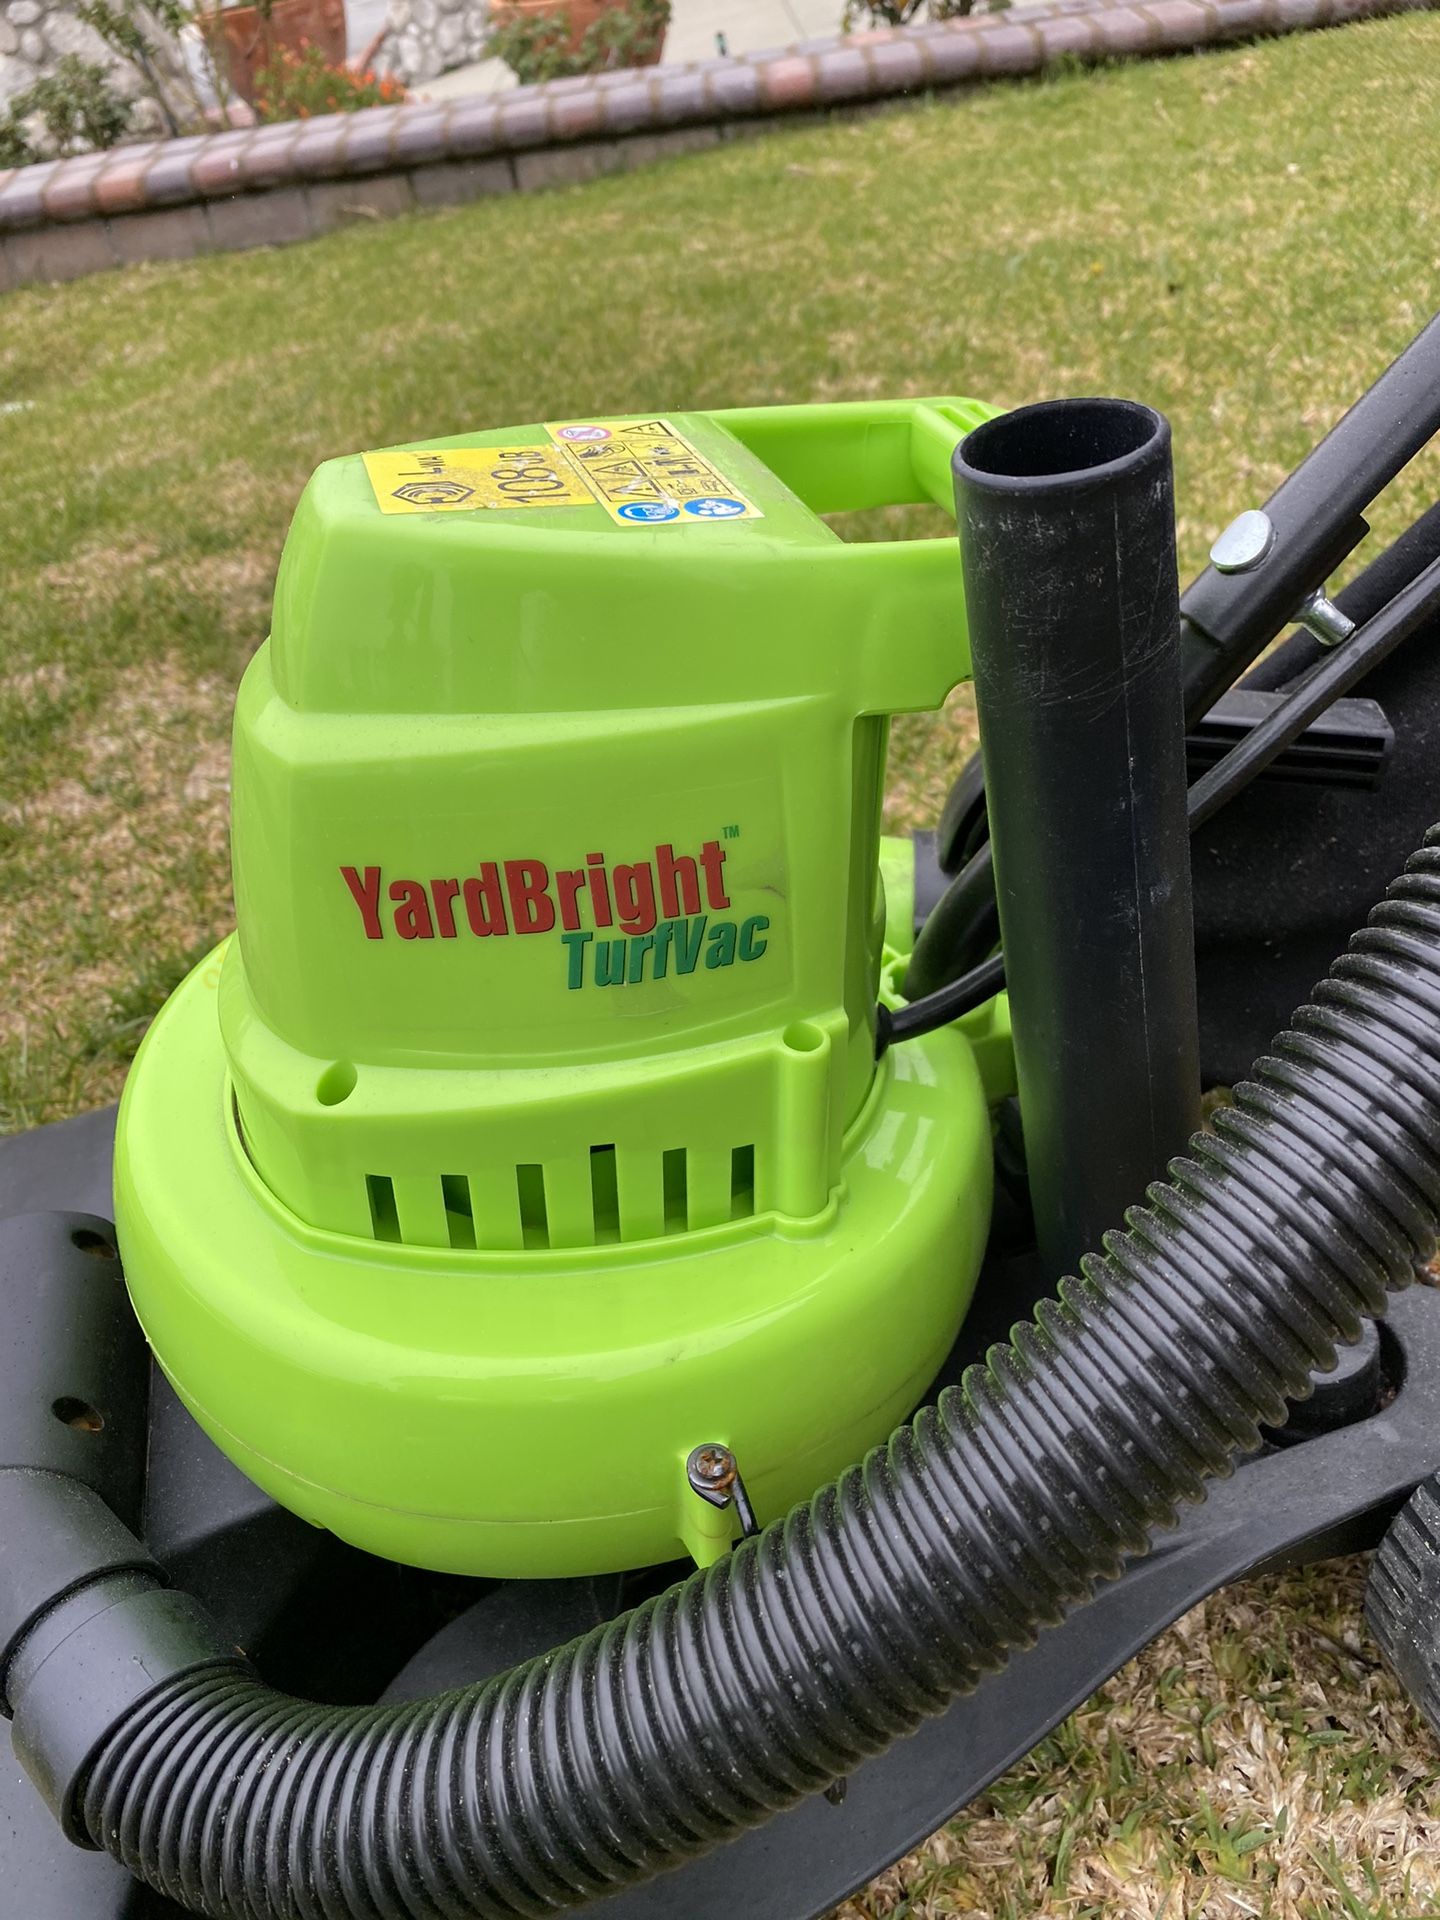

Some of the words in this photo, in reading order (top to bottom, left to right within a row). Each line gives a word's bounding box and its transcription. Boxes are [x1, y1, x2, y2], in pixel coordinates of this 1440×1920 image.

[491, 467, 571, 503] 108
[339, 840, 731, 940] YardBright
[561, 914, 770, 990] TurfVac
